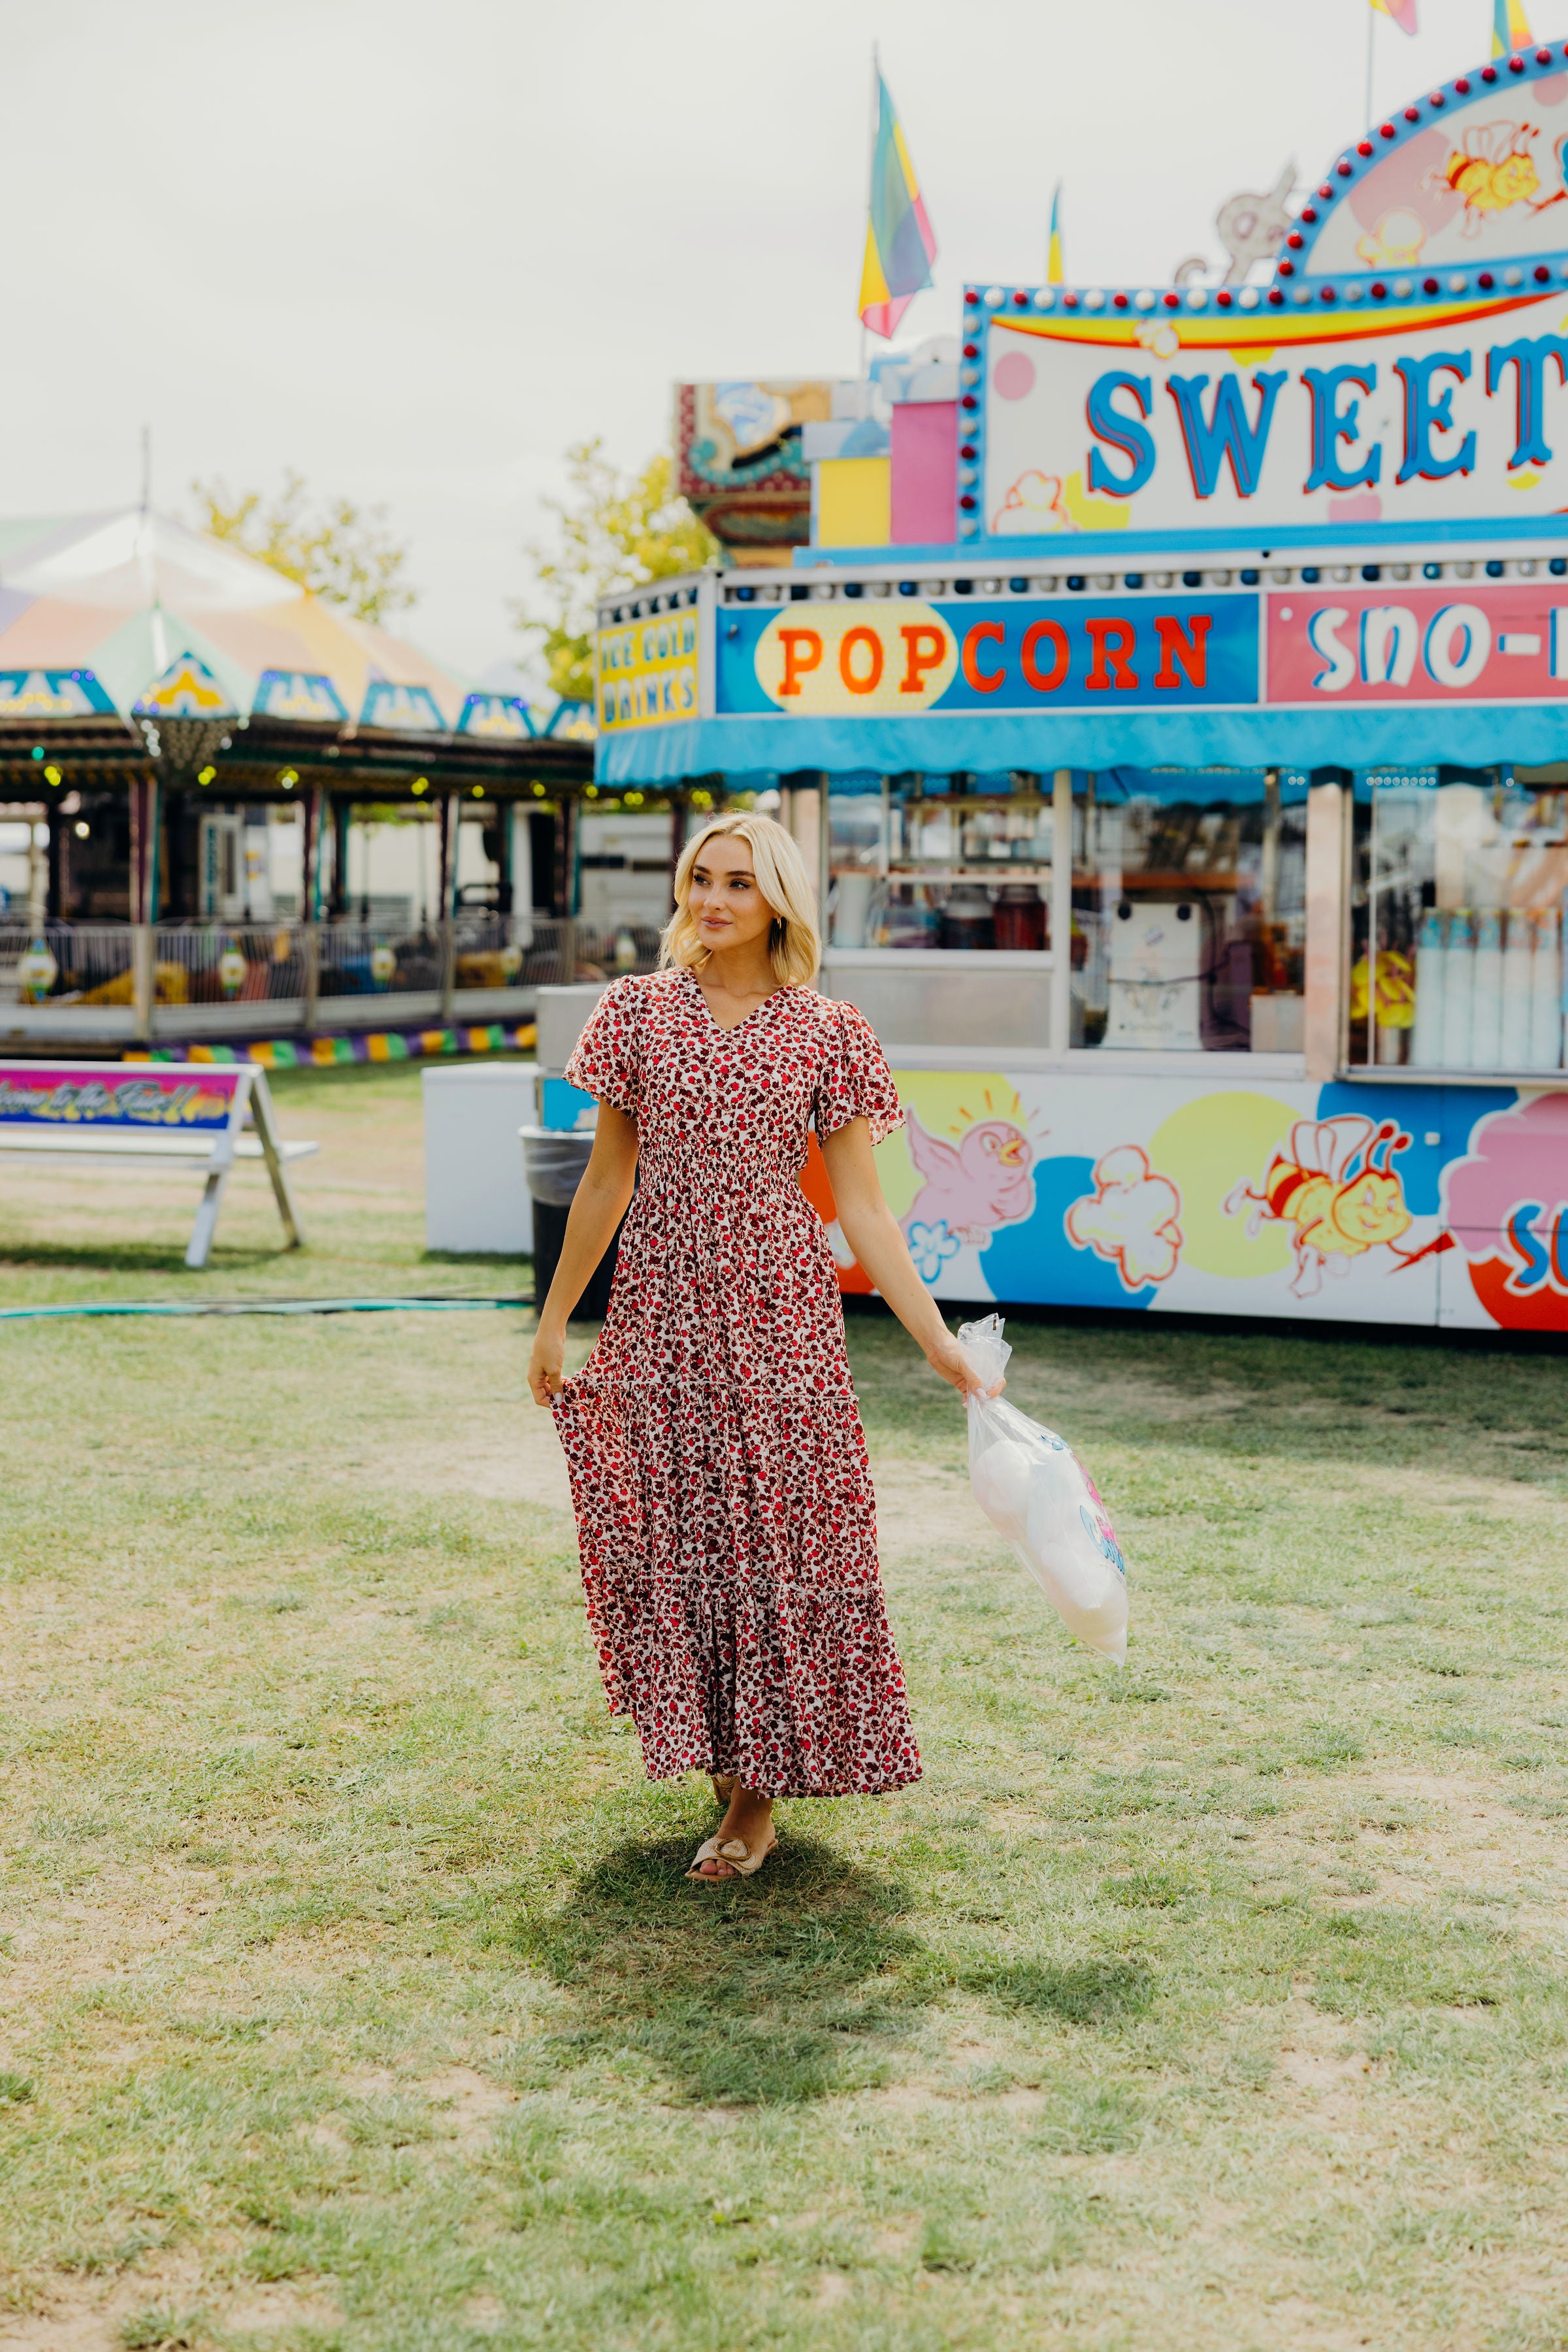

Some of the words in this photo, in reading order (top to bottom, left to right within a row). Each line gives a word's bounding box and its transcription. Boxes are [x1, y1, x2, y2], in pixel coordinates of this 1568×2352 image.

[1086, 334, 1568, 498] SWEET
[601, 630, 636, 671] ICE
[642, 615, 696, 662] COLD
[777, 614, 1212, 696] POPCORN
[602, 665, 695, 723] DRINKS
